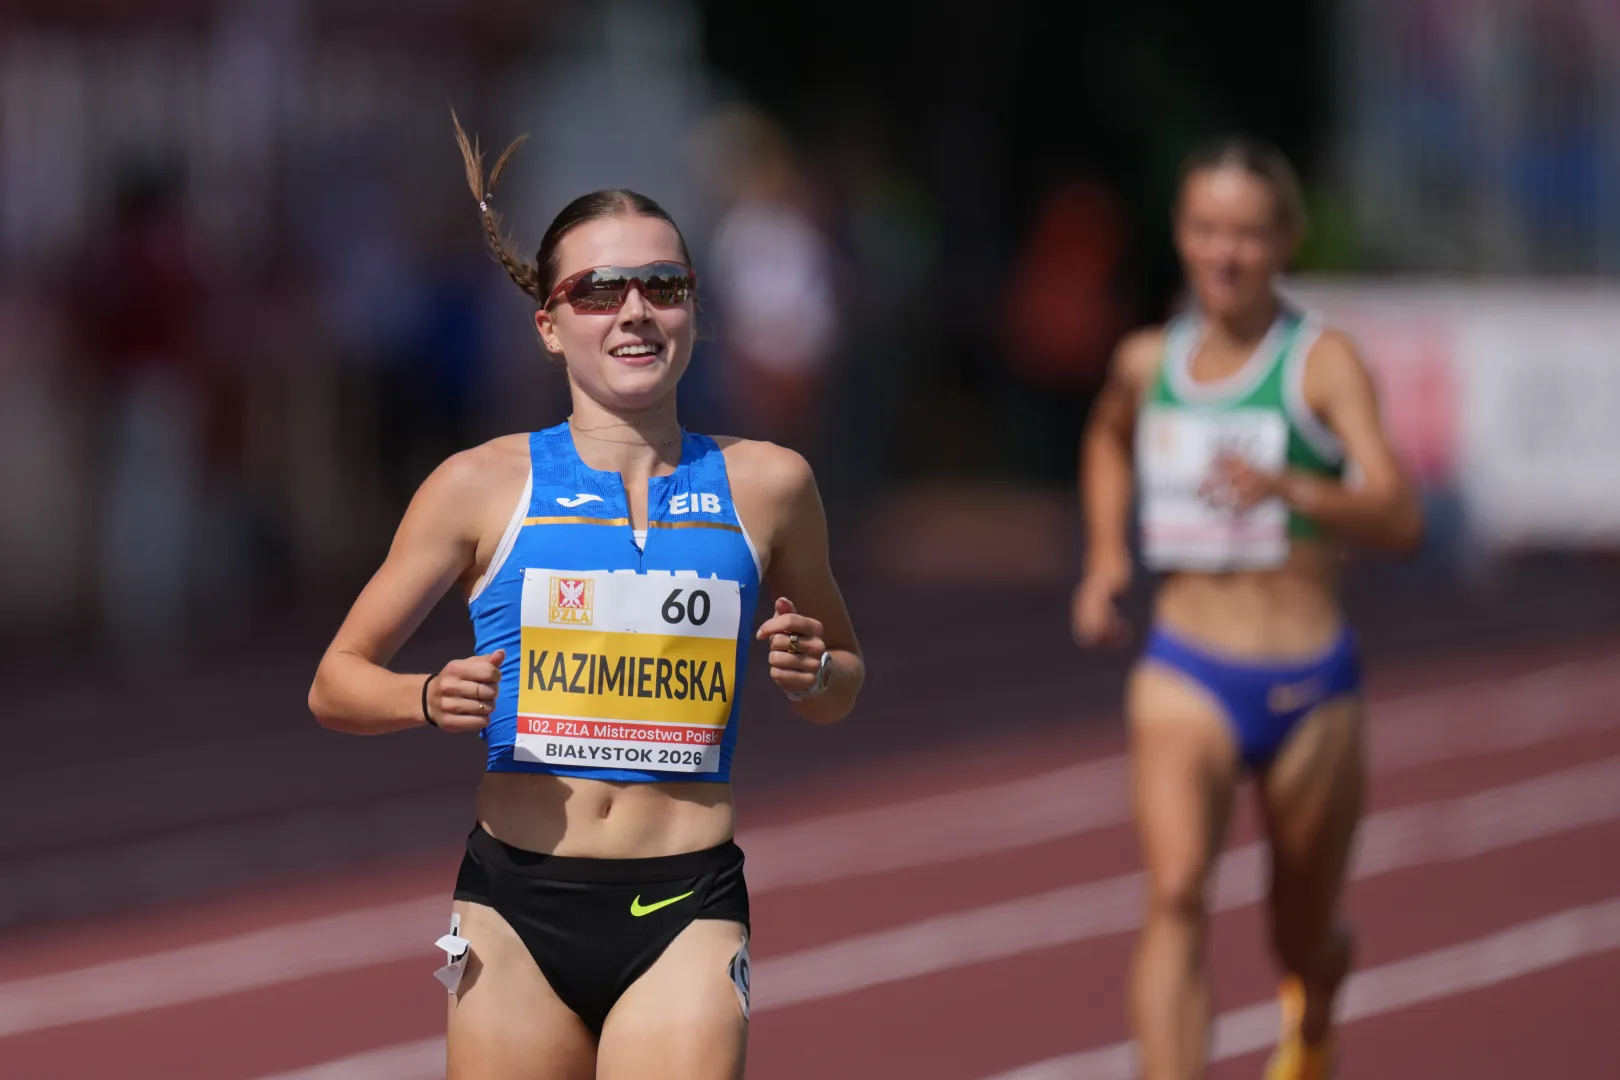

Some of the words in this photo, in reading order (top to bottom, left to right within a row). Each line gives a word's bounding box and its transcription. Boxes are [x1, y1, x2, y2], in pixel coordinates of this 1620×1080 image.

[669, 493, 721, 514] EIB
[551, 609, 589, 623] PZLA
[661, 588, 711, 626] 60
[527, 649, 727, 703] KAZIMIERSKA
[528, 719, 552, 735] 102.
[556, 721, 590, 737] PZLA
[594, 725, 683, 742] Mistrzostwa
[545, 743, 653, 763] BIAŁYSTOK
[657, 749, 702, 766] 2026
